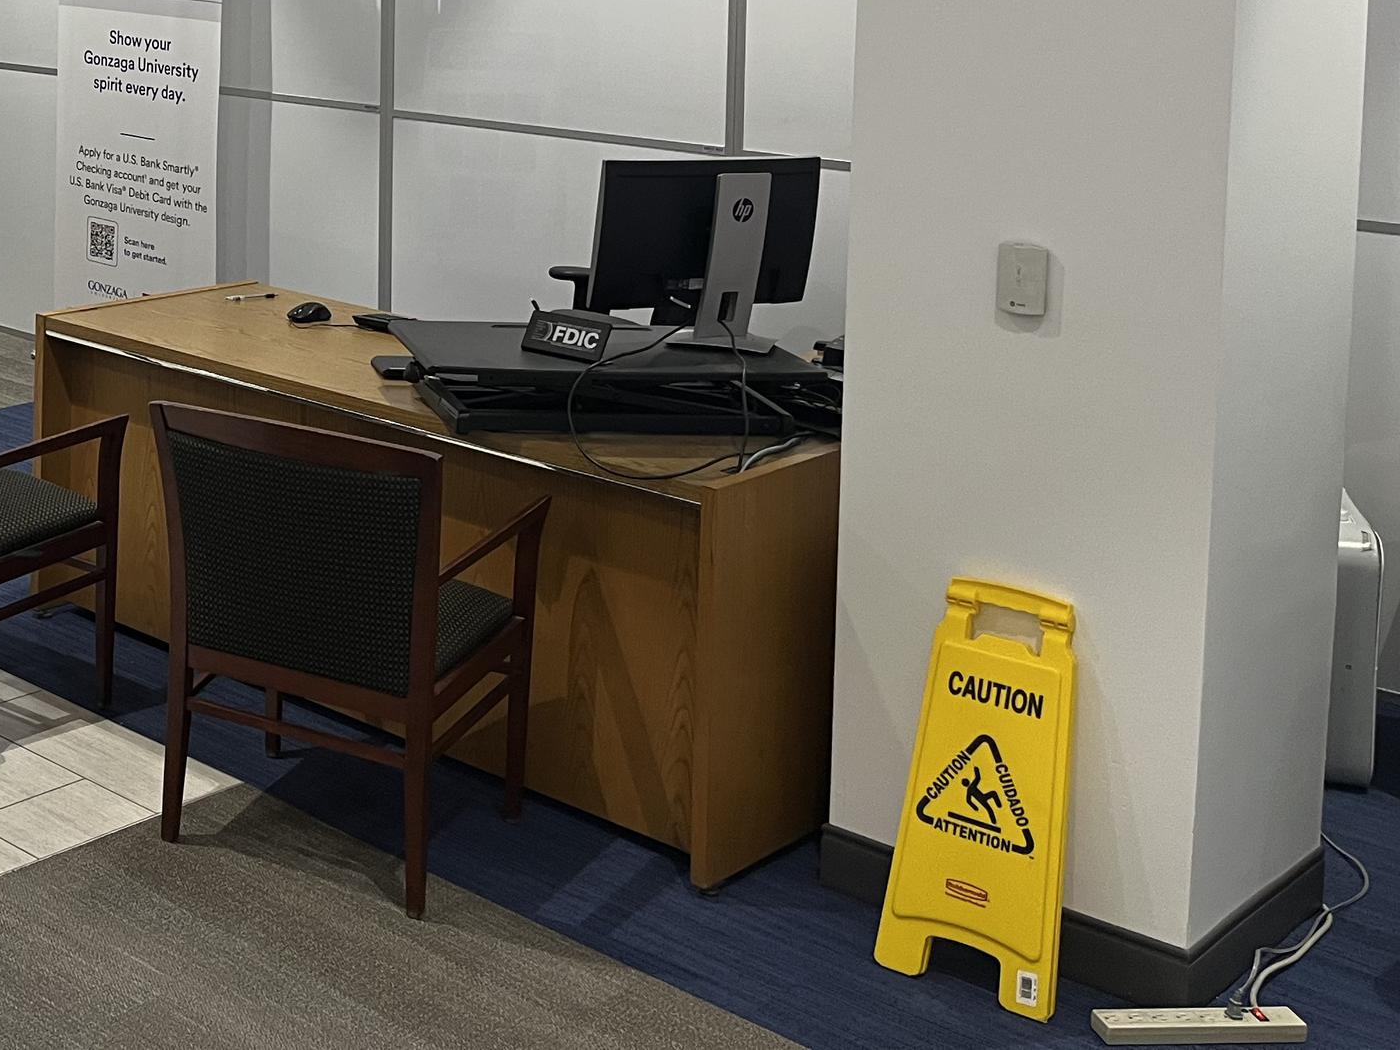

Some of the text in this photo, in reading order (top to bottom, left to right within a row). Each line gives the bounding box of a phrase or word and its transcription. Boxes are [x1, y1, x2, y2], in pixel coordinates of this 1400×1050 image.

[109, 30, 171, 52] Show your
[84, 50, 199, 82] Gonzaga University
[94, 76, 186, 105] spirit every day.
[79, 145, 101, 160] Apply
[103, 149, 114, 160] for
[116, 154, 121, 162] a
[123, 153, 138, 165] U.S.
[141, 156, 161, 169] Bank
[76, 160, 111, 179] Checking
[149, 177, 165, 187] and
[166, 181, 179, 191] get
[182, 183, 201, 194] your
[69, 175, 84, 187] U.S.
[85, 178, 104, 191] Bank
[128, 187, 150, 201] Debit
[152, 192, 171, 206] Card
[174, 197, 193, 210] with
[195, 202, 207, 213] the
[84, 194, 190, 227] Gonzaga University design.
[734, 198, 752, 222] hp
[124, 236, 155, 250] Scan here
[124, 248, 167, 265] to get started.
[87, 280, 128, 300] GONZAGA
[552, 325, 599, 349] FDIC
[948, 670, 1044, 719] CAUTION
[926, 750, 971, 800] CAUTION
[995, 763, 1029, 827] CUIDADO
[933, 817, 1011, 853] ATTENTION
